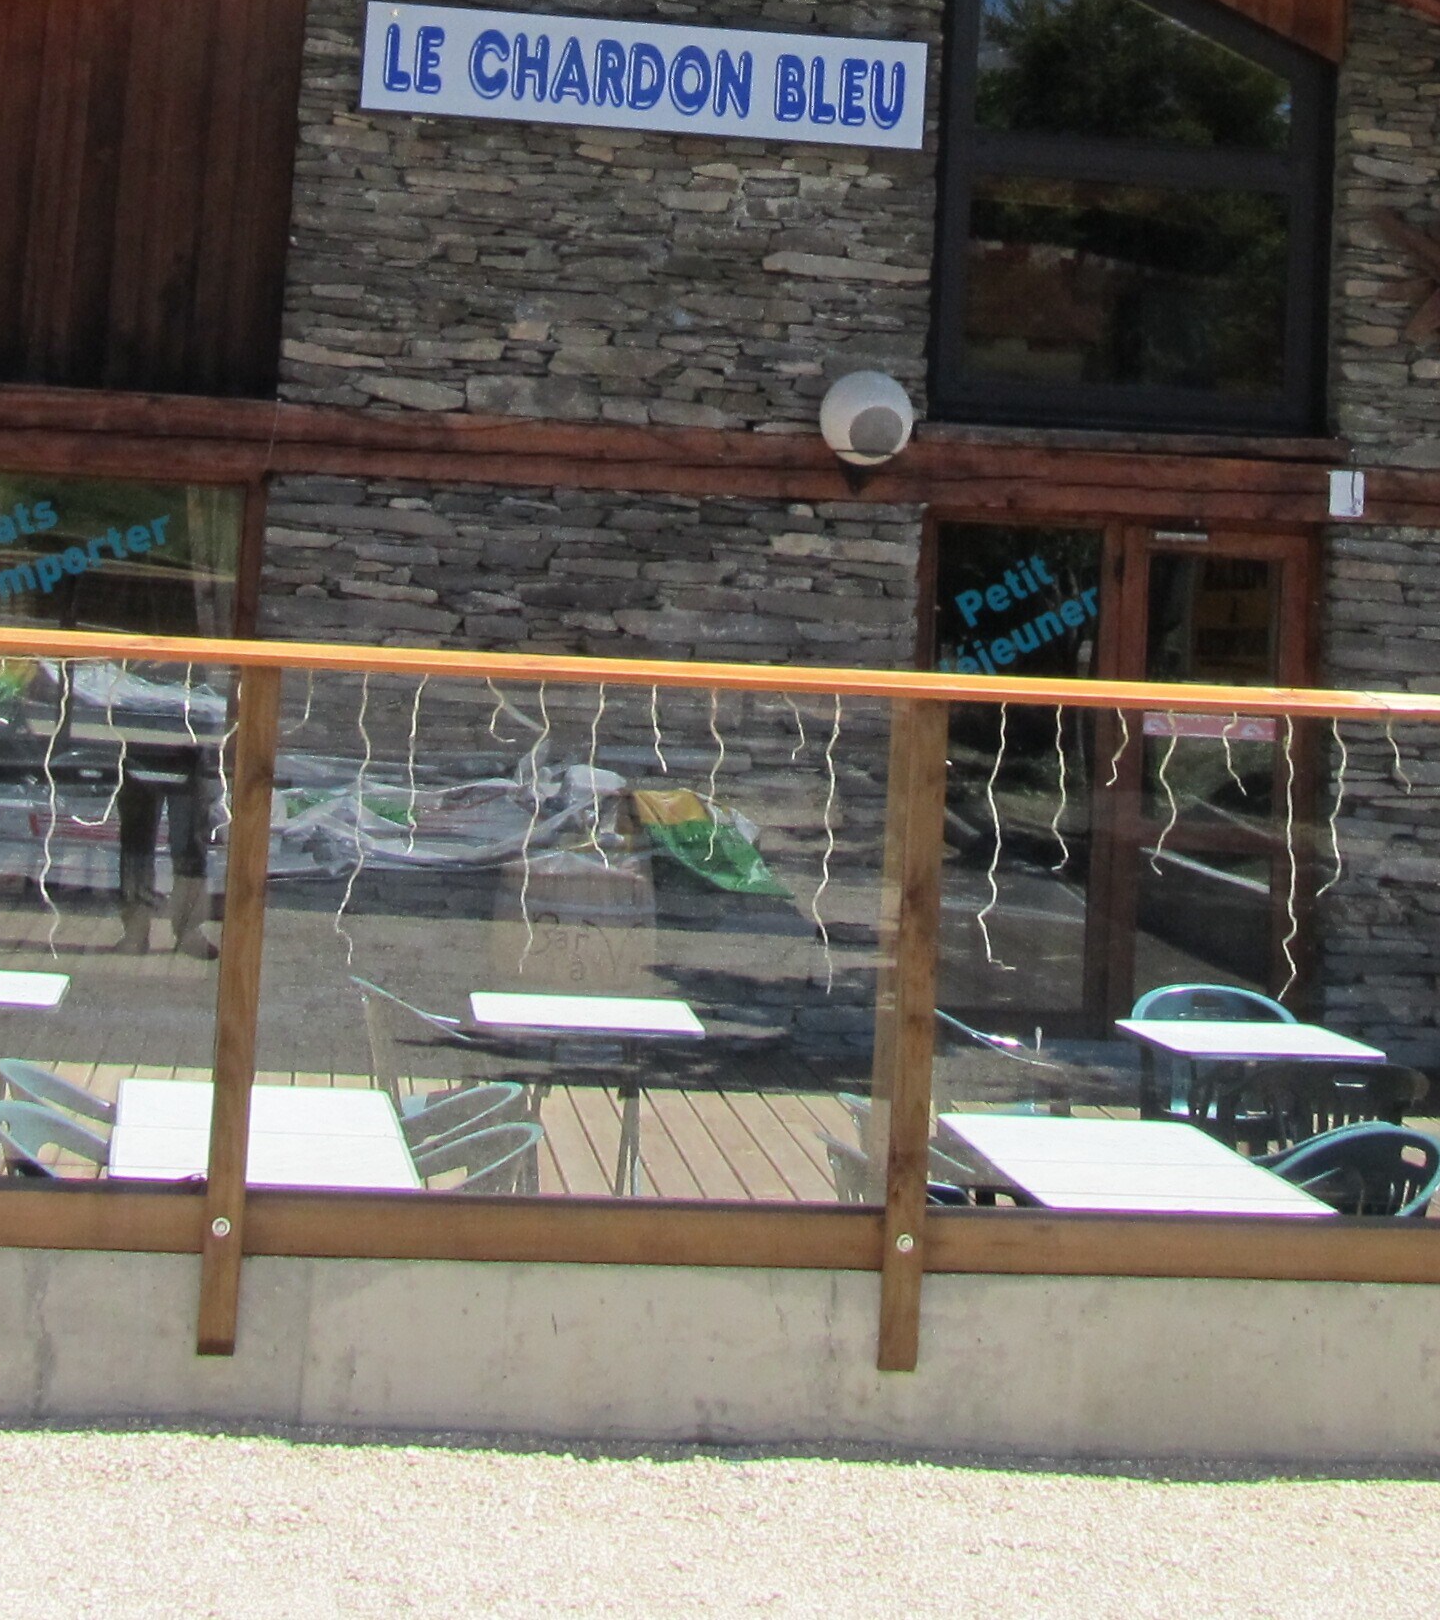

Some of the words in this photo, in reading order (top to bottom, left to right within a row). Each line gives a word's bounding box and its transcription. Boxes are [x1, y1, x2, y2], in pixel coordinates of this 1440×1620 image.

[382, 22, 446, 94] LE
[468, 28, 754, 118] CHARDON
[774, 53, 907, 130] BLEU
[954, 555, 1054, 628] Petit
